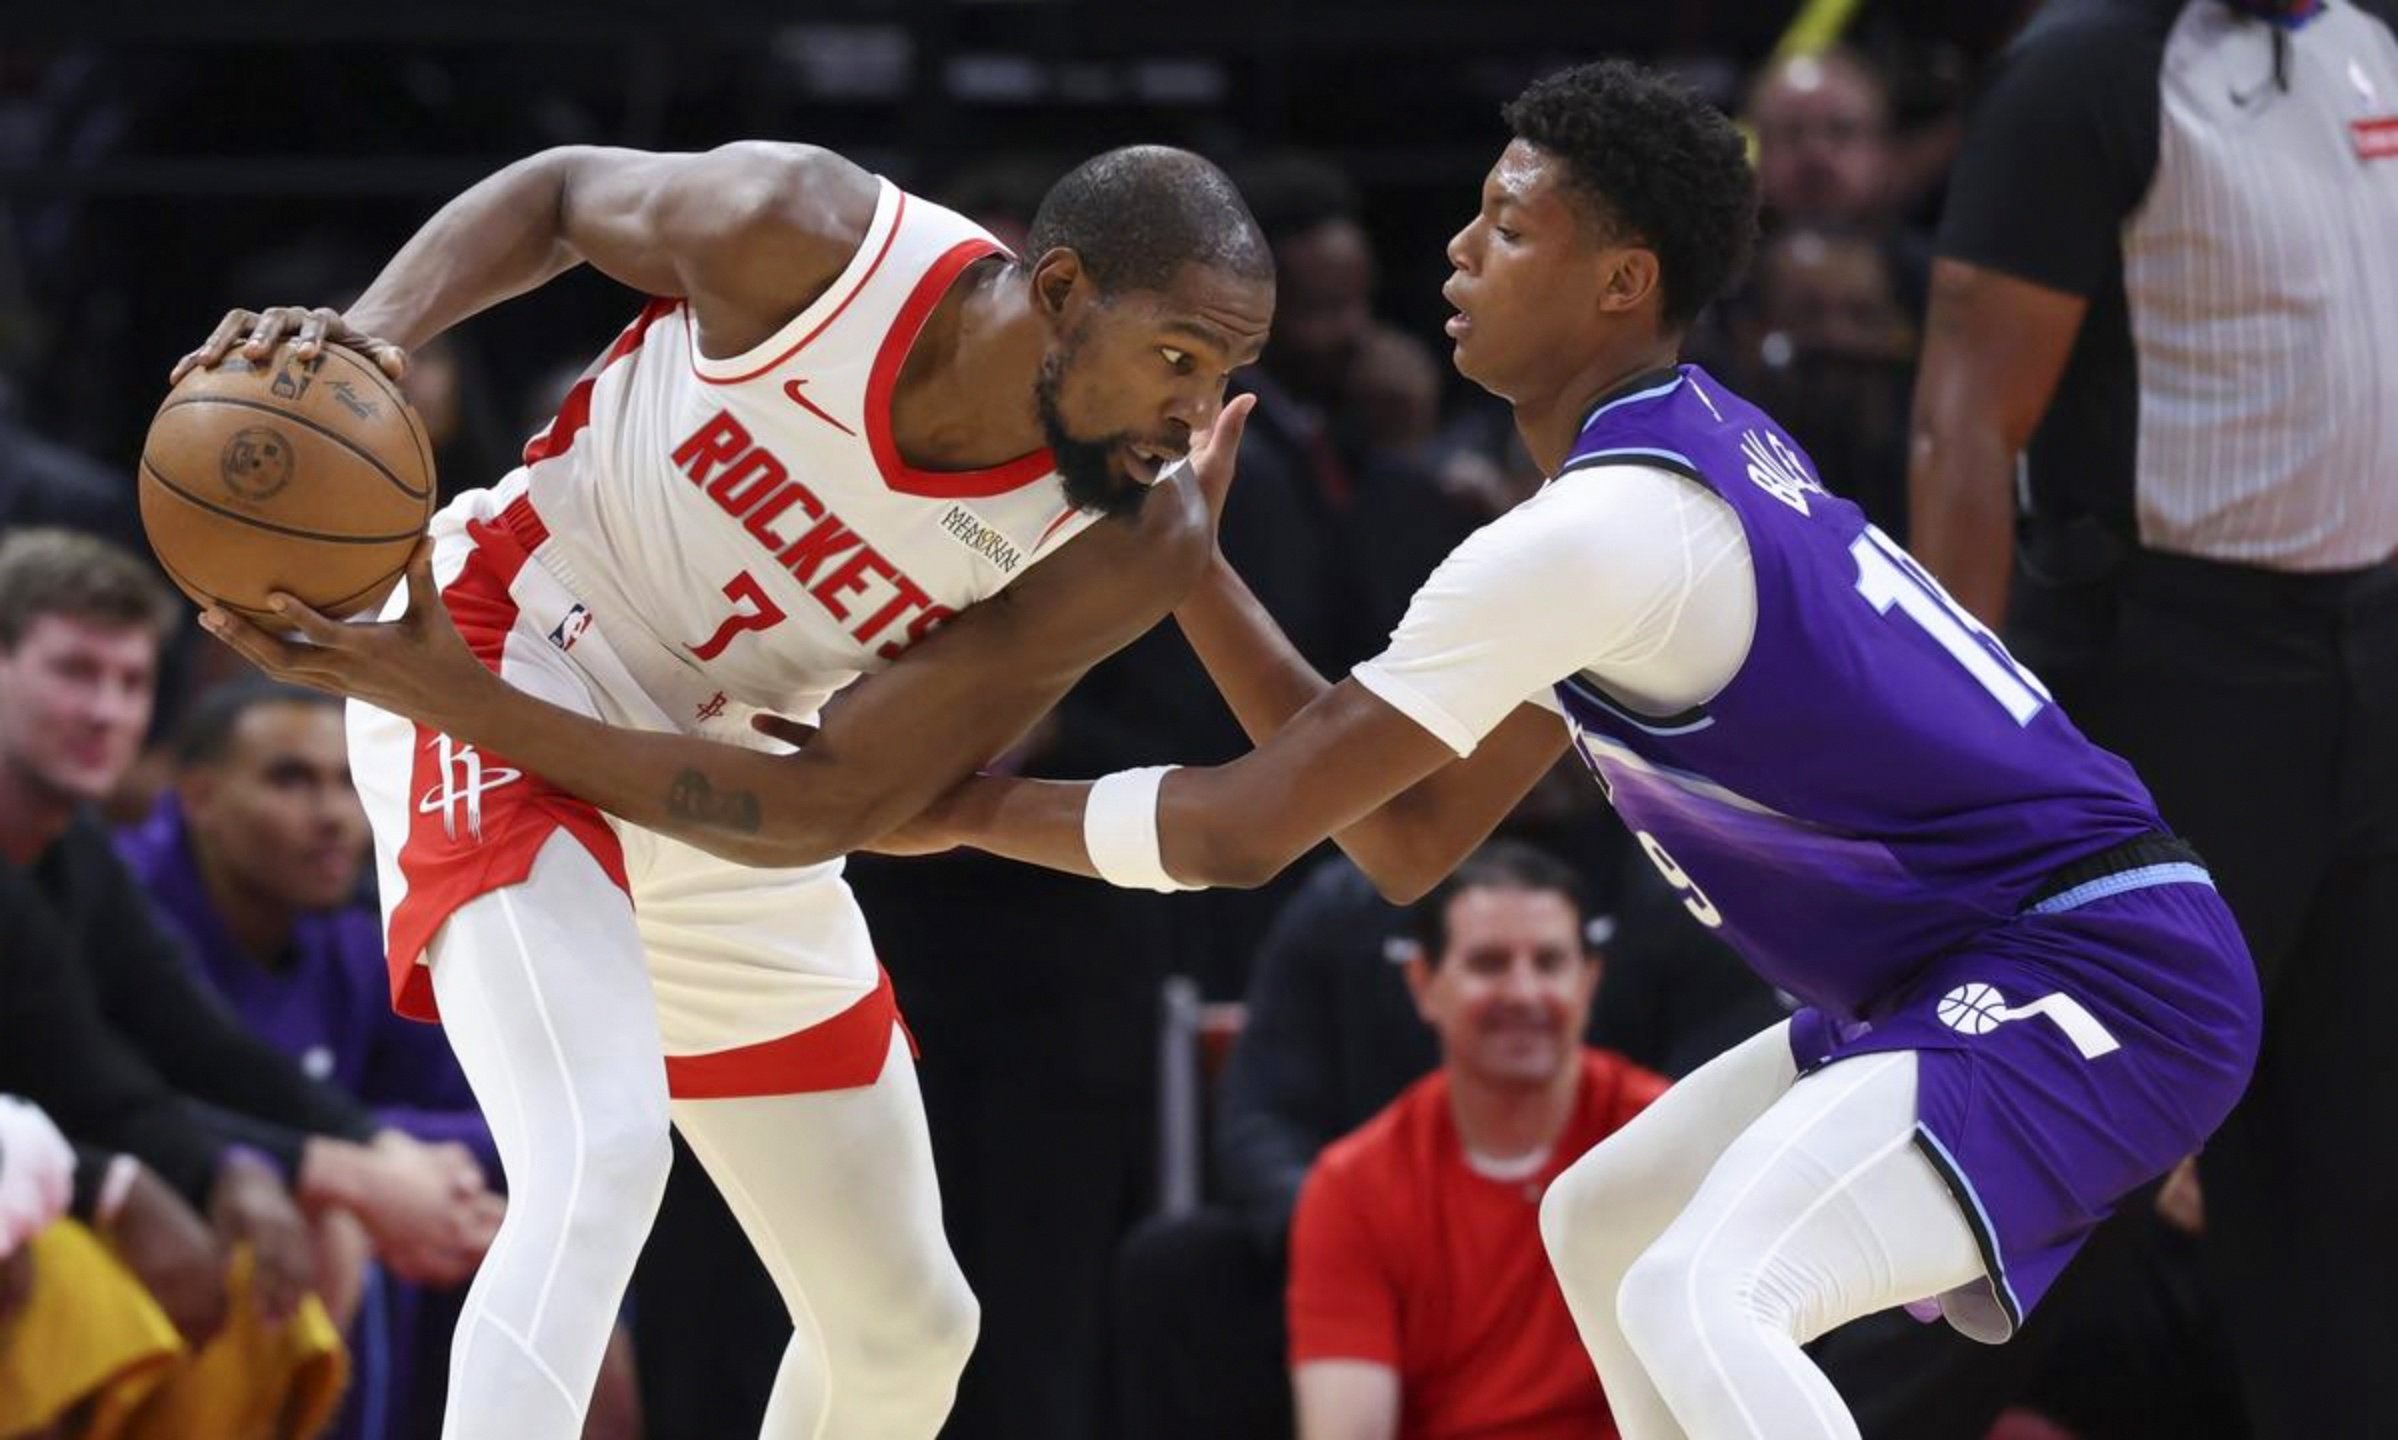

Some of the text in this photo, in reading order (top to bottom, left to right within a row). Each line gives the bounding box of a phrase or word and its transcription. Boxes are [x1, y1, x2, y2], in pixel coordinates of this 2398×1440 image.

[671, 409, 955, 660] ROCKETS
[941, 513, 1012, 573] HERMANN
[945, 506, 1021, 567] MEMORIAL
[682, 570, 787, 661] 7
